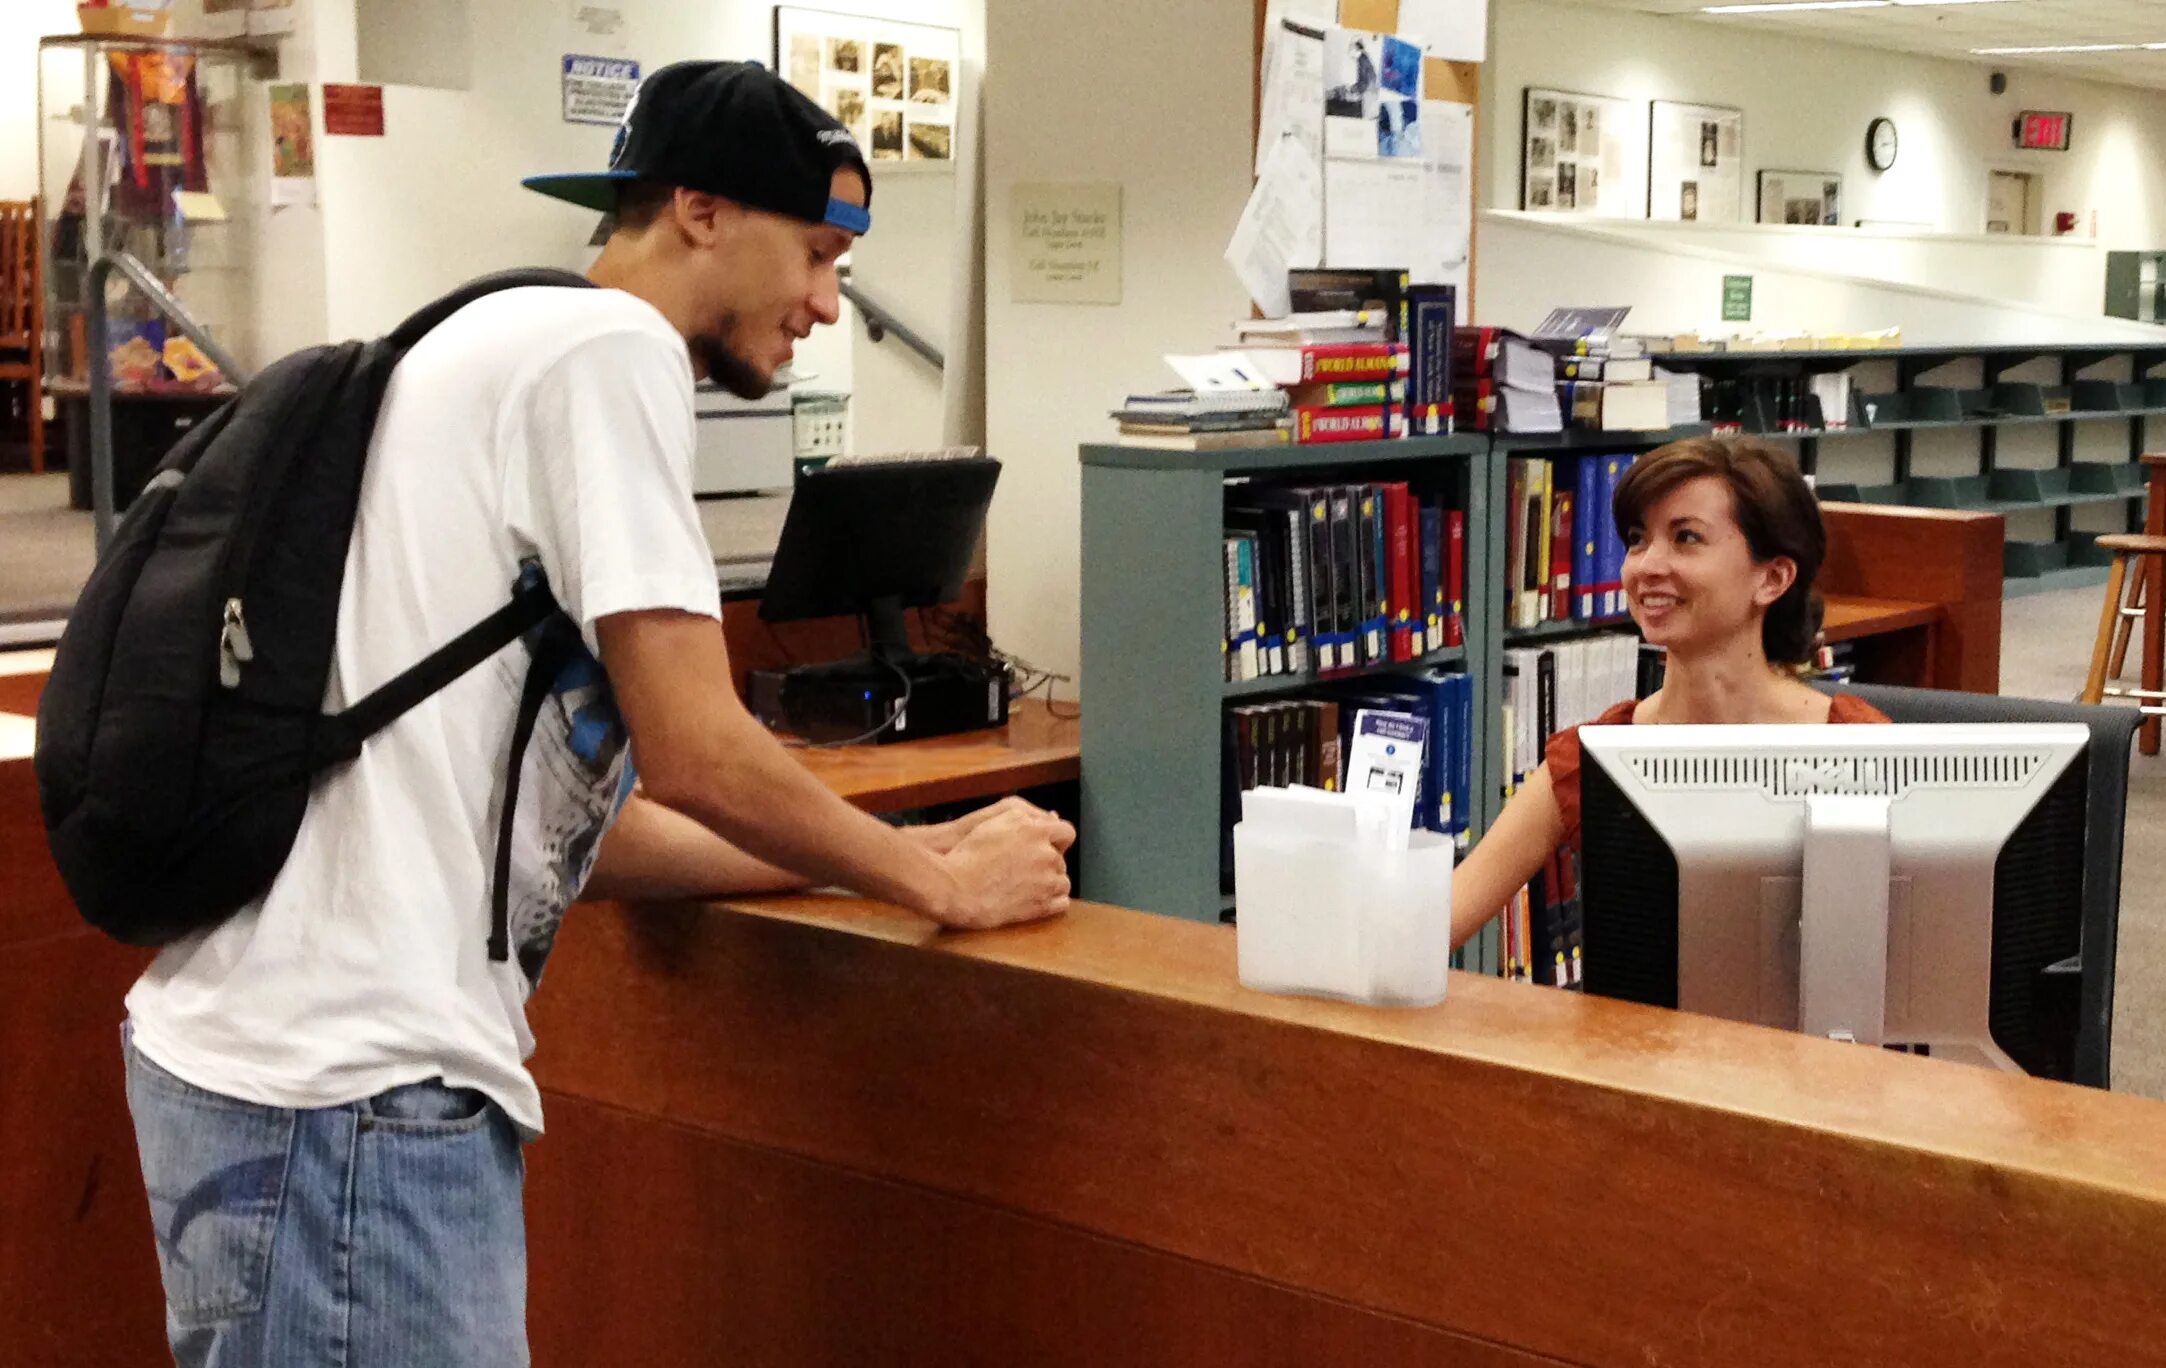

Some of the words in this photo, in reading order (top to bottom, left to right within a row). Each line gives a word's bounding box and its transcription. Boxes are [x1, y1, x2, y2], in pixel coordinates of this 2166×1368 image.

[572, 60, 632, 79] NOTICE
[2024, 114, 2065, 147] EXIT
[1319, 357, 1354, 372] WORLD
[1318, 416, 1350, 431] WORLD
